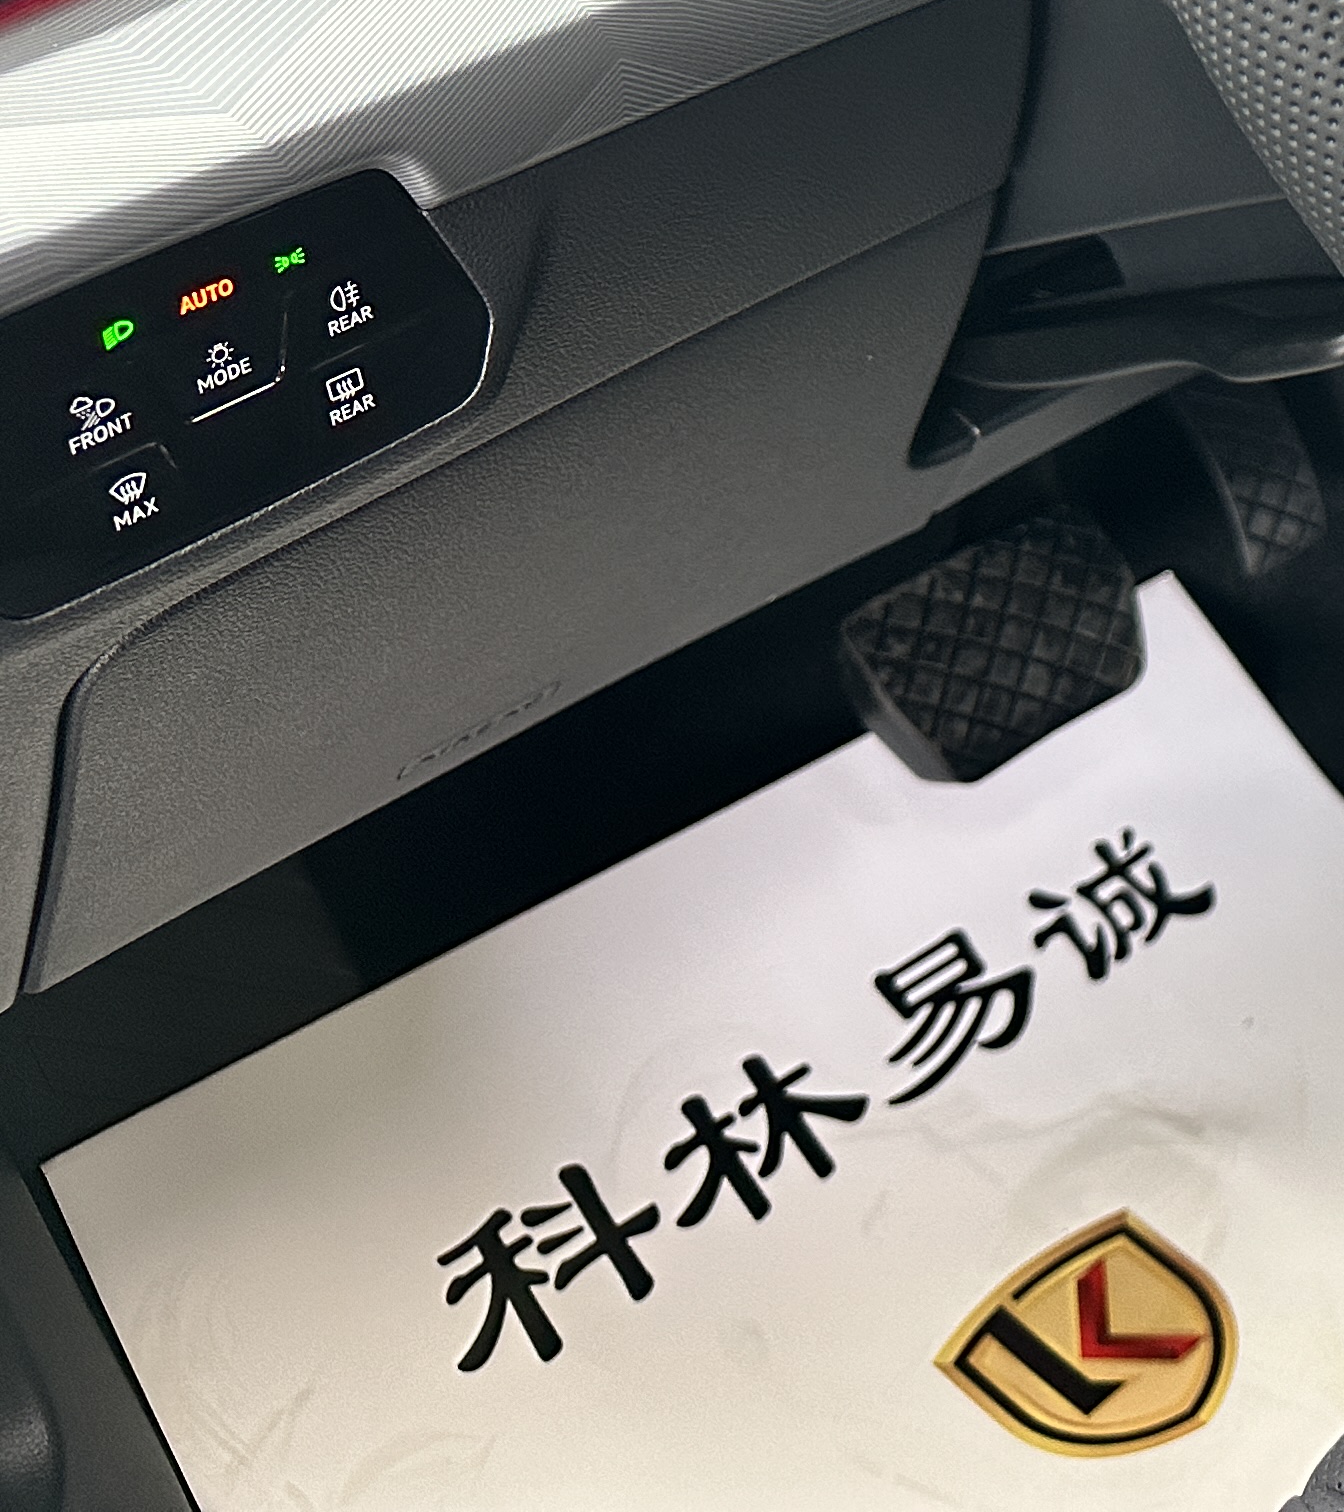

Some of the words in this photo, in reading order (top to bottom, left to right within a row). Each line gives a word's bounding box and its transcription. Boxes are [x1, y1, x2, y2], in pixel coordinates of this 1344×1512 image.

[180, 278, 234, 315] AUTO
[327, 305, 374, 337] REAR
[197, 356, 252, 394] MODE
[329, 393, 376, 426] REAR
[68, 411, 133, 455] FRONT
[113, 496, 159, 531] MAX
